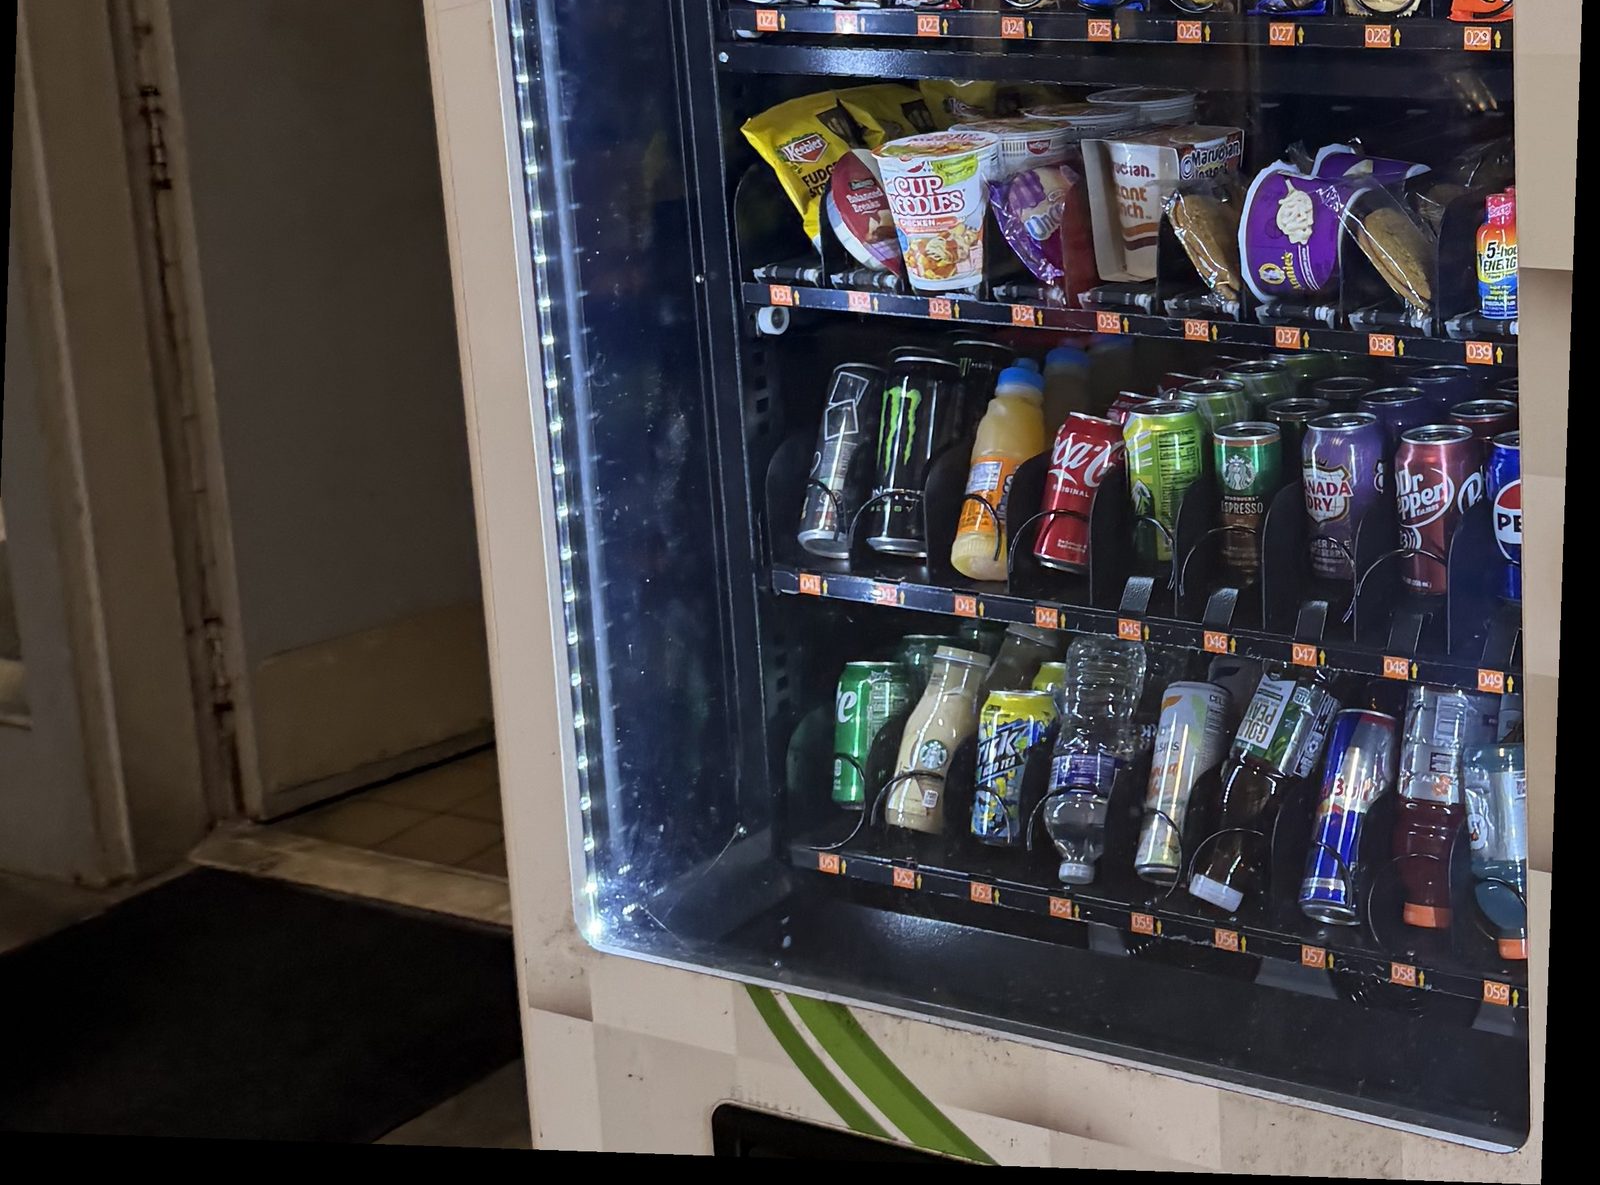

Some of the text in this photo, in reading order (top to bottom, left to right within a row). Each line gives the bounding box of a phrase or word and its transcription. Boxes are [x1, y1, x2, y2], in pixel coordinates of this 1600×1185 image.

[918, 17, 939, 32] 023
[1003, 19, 1024, 34] 024
[1089, 22, 1112, 37] 025
[1178, 23, 1201, 39] 026
[1270, 25, 1294, 43] 027
[1465, 30, 1490, 48] 029
[782, 137, 823, 162] Keebler
[802, 161, 837, 187] FUDG
[894, 176, 943, 197] CUP
[846, 188, 883, 204] Balanced
[889, 190, 965, 216] NOODLES
[852, 200, 881, 214] Breaks
[1486, 242, 1517, 259] 5-hou
[1483, 257, 1517, 273] ENERG
[772, 289, 792, 302] 031
[930, 300, 952, 314] 033
[1014, 307, 1034, 321] 034
[1097, 313, 1120, 329] 035
[1185, 321, 1209, 336] 036
[1276, 329, 1300, 344] 037
[1369, 336, 1395, 352] 038
[1467, 344, 1491, 359] 039
[1305, 479, 1354, 497] NADA
[1397, 468, 1424, 496] Dr
[1306, 497, 1332, 513] DRY
[1397, 482, 1446, 521] pper
[801, 578, 820, 592] 041
[956, 599, 976, 614] 043
[1037, 610, 1058, 624] 044
[1119, 621, 1141, 638] 045
[1204, 634, 1227, 651] 046
[1292, 647, 1316, 663] 047
[1384, 658, 1408, 676] 048
[1479, 671, 1504, 689] 049
[1000, 755, 1016, 770] TEA
[820, 855, 838, 869] 051
[1051, 899, 1071, 914] 054
[1216, 930, 1237, 946] 056
[1302, 947, 1326, 962] 057
[1392, 964, 1416, 981] 058
[1484, 982, 1509, 1000] 059
